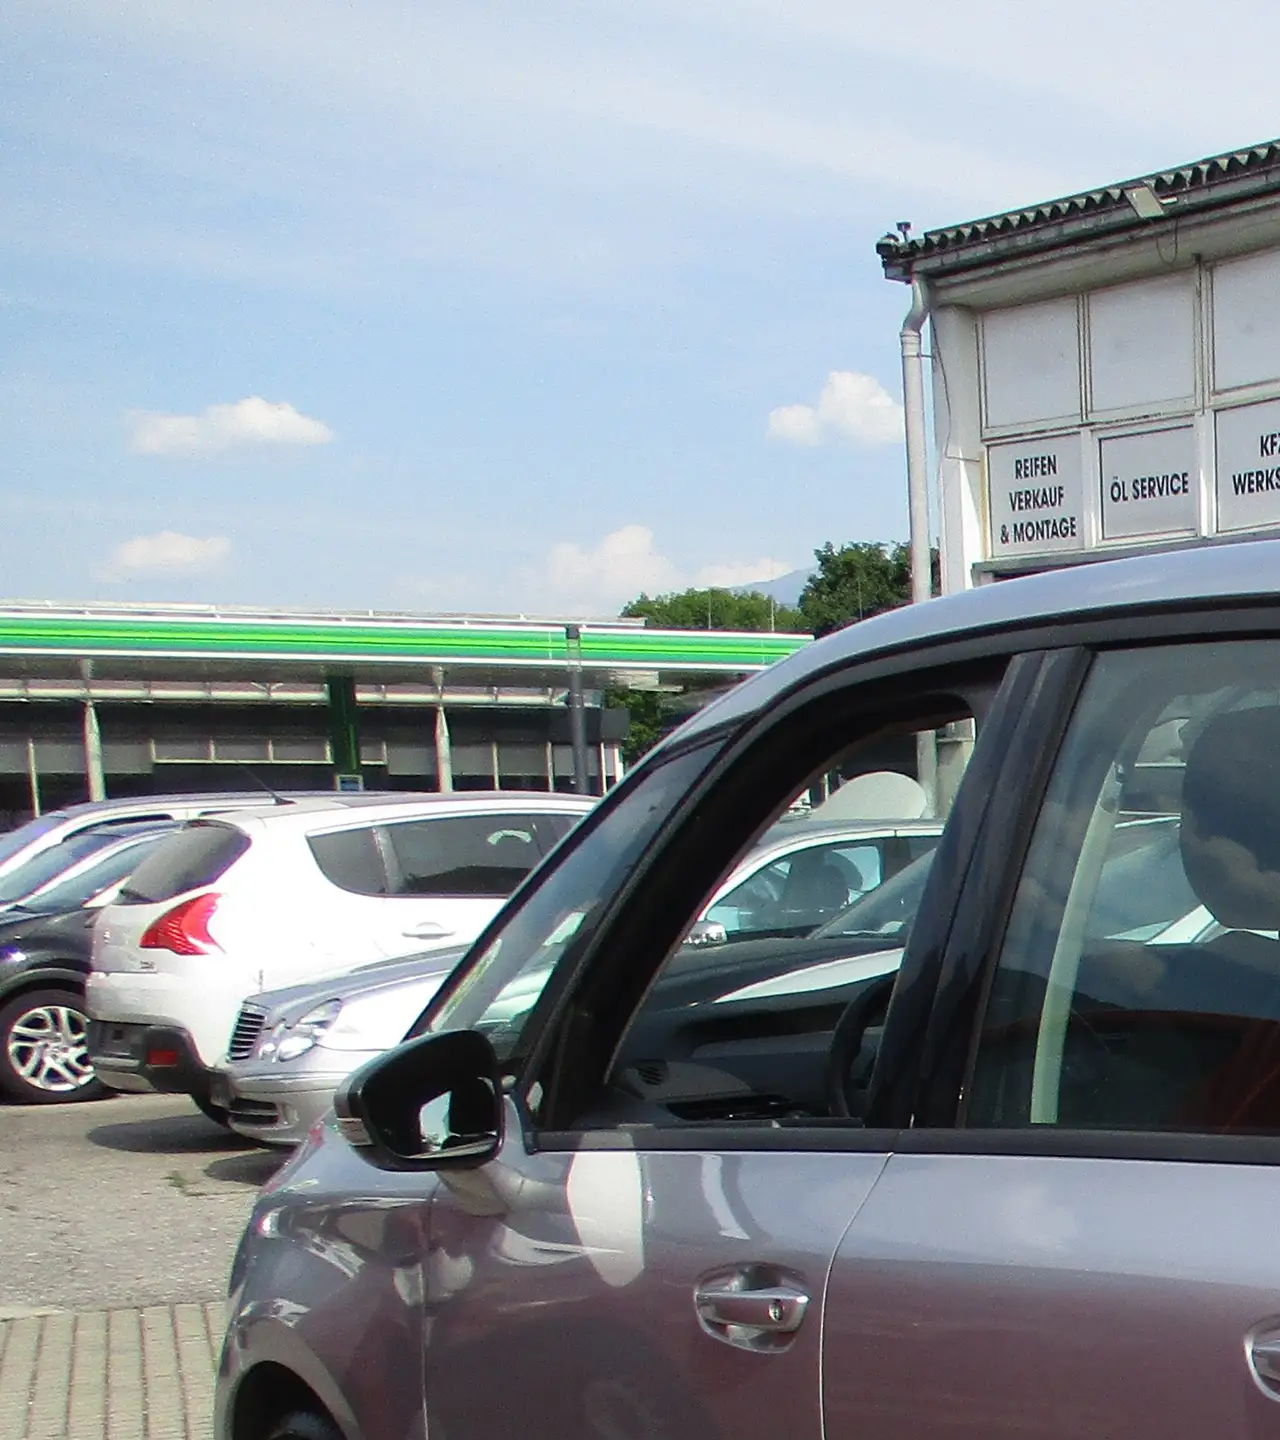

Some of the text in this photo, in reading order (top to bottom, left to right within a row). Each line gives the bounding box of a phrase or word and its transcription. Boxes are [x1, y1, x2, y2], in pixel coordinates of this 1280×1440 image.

[1015, 454, 1057, 480] REIFEN
[1009, 486, 1064, 512] VERKAUF
[1110, 472, 1189, 503] ÖL SERVICE
[1000, 517, 1077, 545] & MONTAGE
